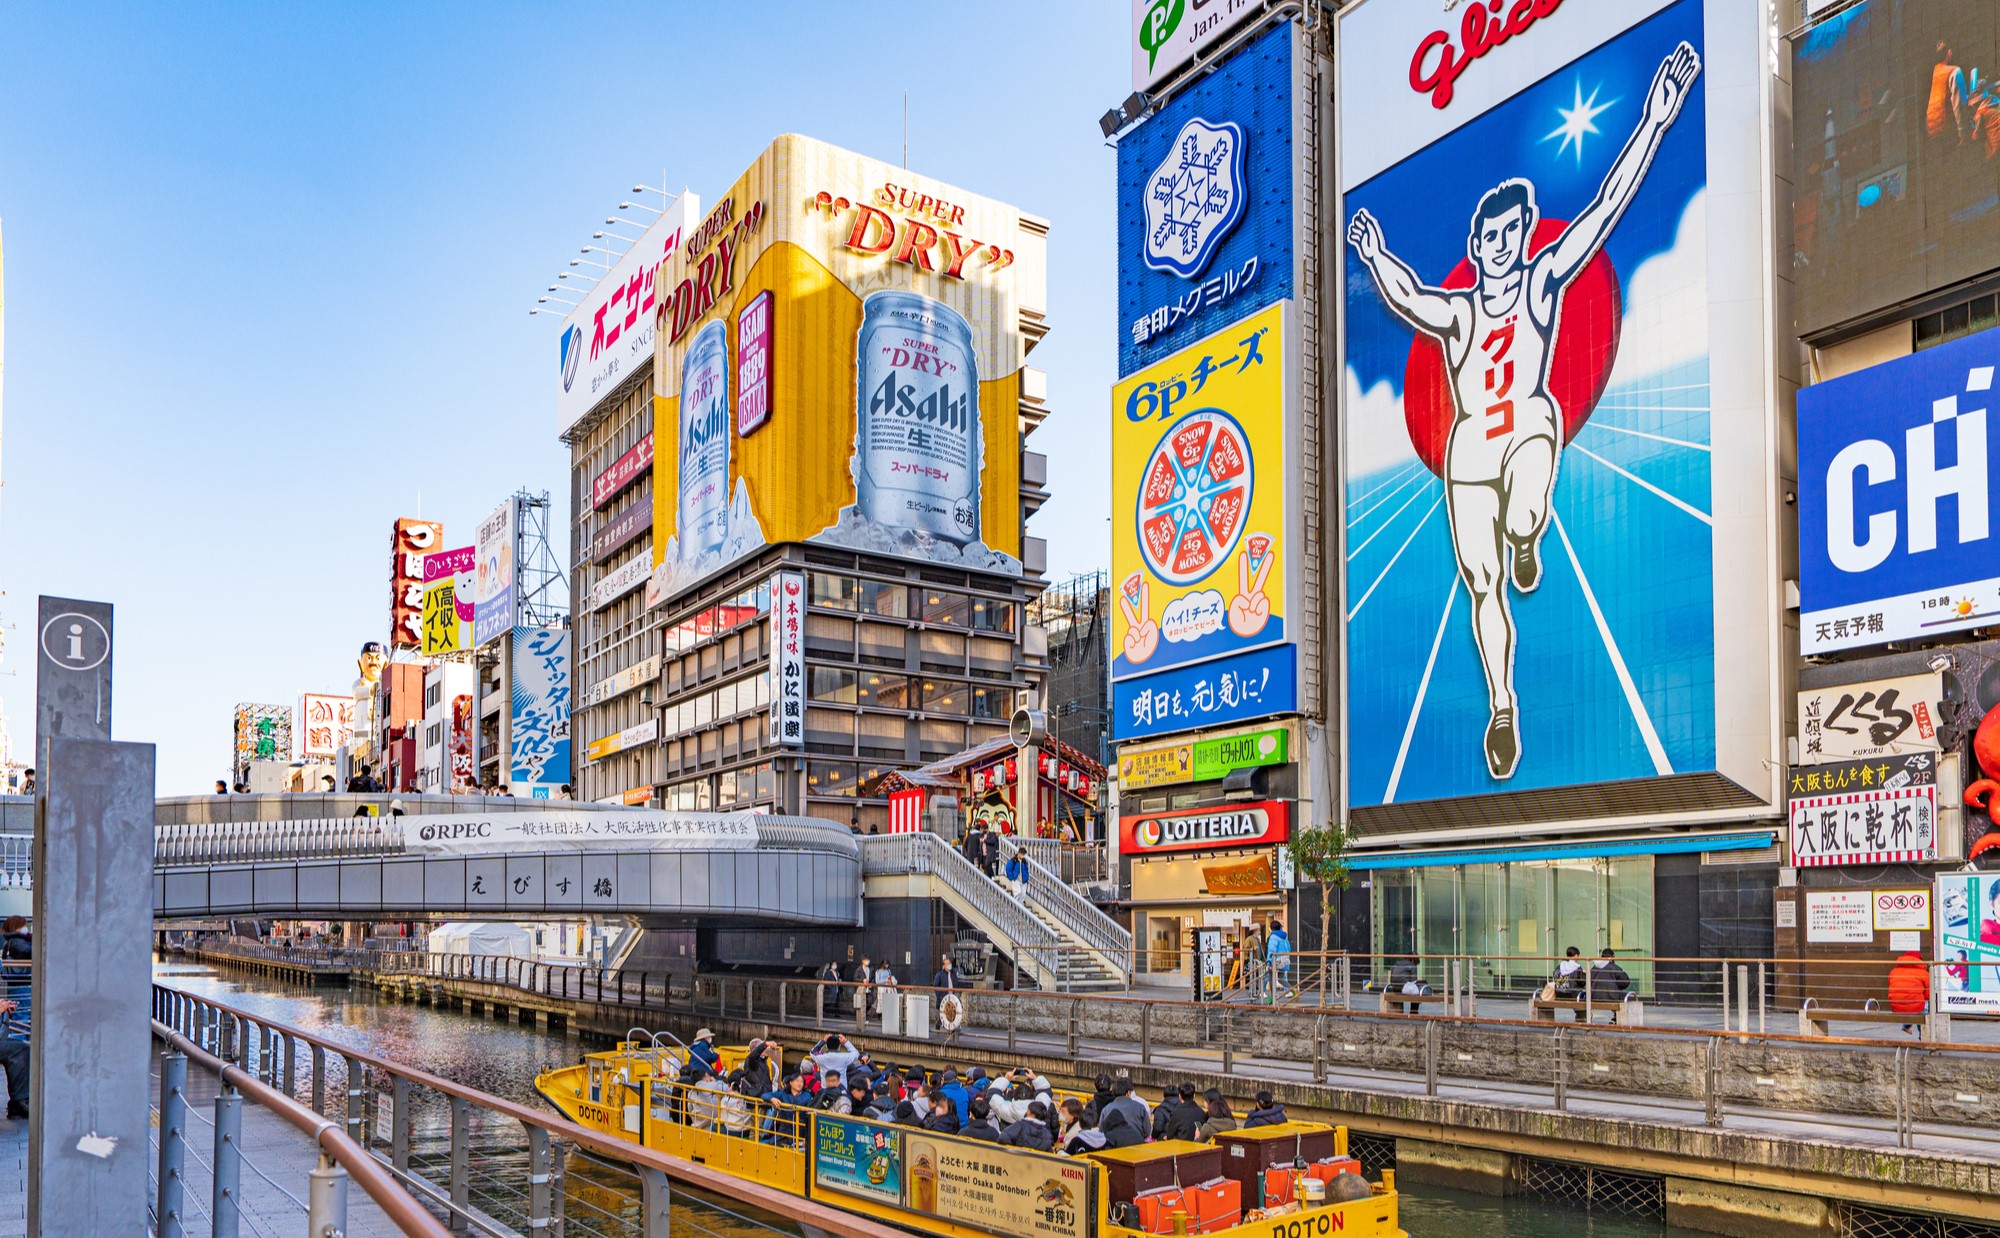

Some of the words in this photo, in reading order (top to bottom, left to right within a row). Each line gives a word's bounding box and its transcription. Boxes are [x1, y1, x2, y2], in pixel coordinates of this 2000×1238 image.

[1189, 12, 1224, 43] Jan.
[881, 182, 966, 226] SUPER
[686, 197, 733, 265] SUPER
[1132, 256, 1258, 345] 雪印メグミルク
[631, 323, 653, 356] SINCE
[740, 303, 766, 352] ASAHI
[903, 338, 939, 355] SUPER
[739, 347, 766, 395] 1889
[1160, 373, 1183, 388] ロッピー
[1480, 314, 1518, 441] グリコ
[739, 384, 765, 429] OSAKA
[870, 370, 966, 434] Asahi
[684, 394, 724, 466] Asahi
[907, 428, 932, 450] 生
[1178, 424, 1207, 446] SNOW
[1183, 446, 1201, 458] 6P
[1183, 456, 1200, 467] CHEESE
[1214, 452, 1226, 475] 6P
[1221, 435, 1241, 469] SNOW
[891, 461, 949, 482] スーパードライ
[1147, 461, 1165, 500] SNOW
[1158, 472, 1171, 498] 6P
[907, 500, 933, 513] 生ビール
[1214, 498, 1228, 525] 6P
[1221, 496, 1240, 539] SNOW
[480, 509, 508, 546] 店舗の王様
[1146, 526, 1165, 558] SNOW
[1160, 520, 1171, 543] 6P
[1183, 539, 1202, 552] 6P
[1178, 553, 1206, 571] SNOW
[425, 588, 441, 651] バイト
[440, 586, 454, 649] 高収入
[477, 605, 510, 642] ガルフネット
[785, 600, 799, 655] 本場の味
[1816, 613, 1884, 642] 天気予報
[528, 631, 570, 739] シャッターは
[1805, 695, 1822, 755] 道頓堀
[1823, 688, 1913, 746] くくる
[1220, 738, 1256, 765] ピタットハウス
[1852, 747, 1884, 756] KUKURU
[1791, 762, 1891, 794] 大阪もんを食す
[1913, 771, 1932, 785] 2F
[505, 820, 599, 836] 一般社団法人
[604, 819, 749, 836] 大阪活性化事業実行委員会
[1164, 813, 1256, 841] LOTTERIA
[1797, 801, 1913, 855] 大阪に乾杯
[1918, 805, 1930, 838] 検索
[578, 1104, 610, 1126] DOTON
[940, 1155, 964, 1168] ようこそ!
[967, 1160, 979, 1171] 大阪
[1061, 1167, 1084, 1182] KIRIN
[940, 1170, 970, 1184] Welcome!
[973, 1177, 993, 1189] Osaka
[995, 1182, 1030, 1197] Dotonbori
[1035, 1206, 1075, 1228] 一番搾り
[1035, 1220, 1051, 1232] KIRIN
[1052, 1223, 1076, 1238] ICHIBAN
[1273, 1210, 1345, 1238] DOTON
